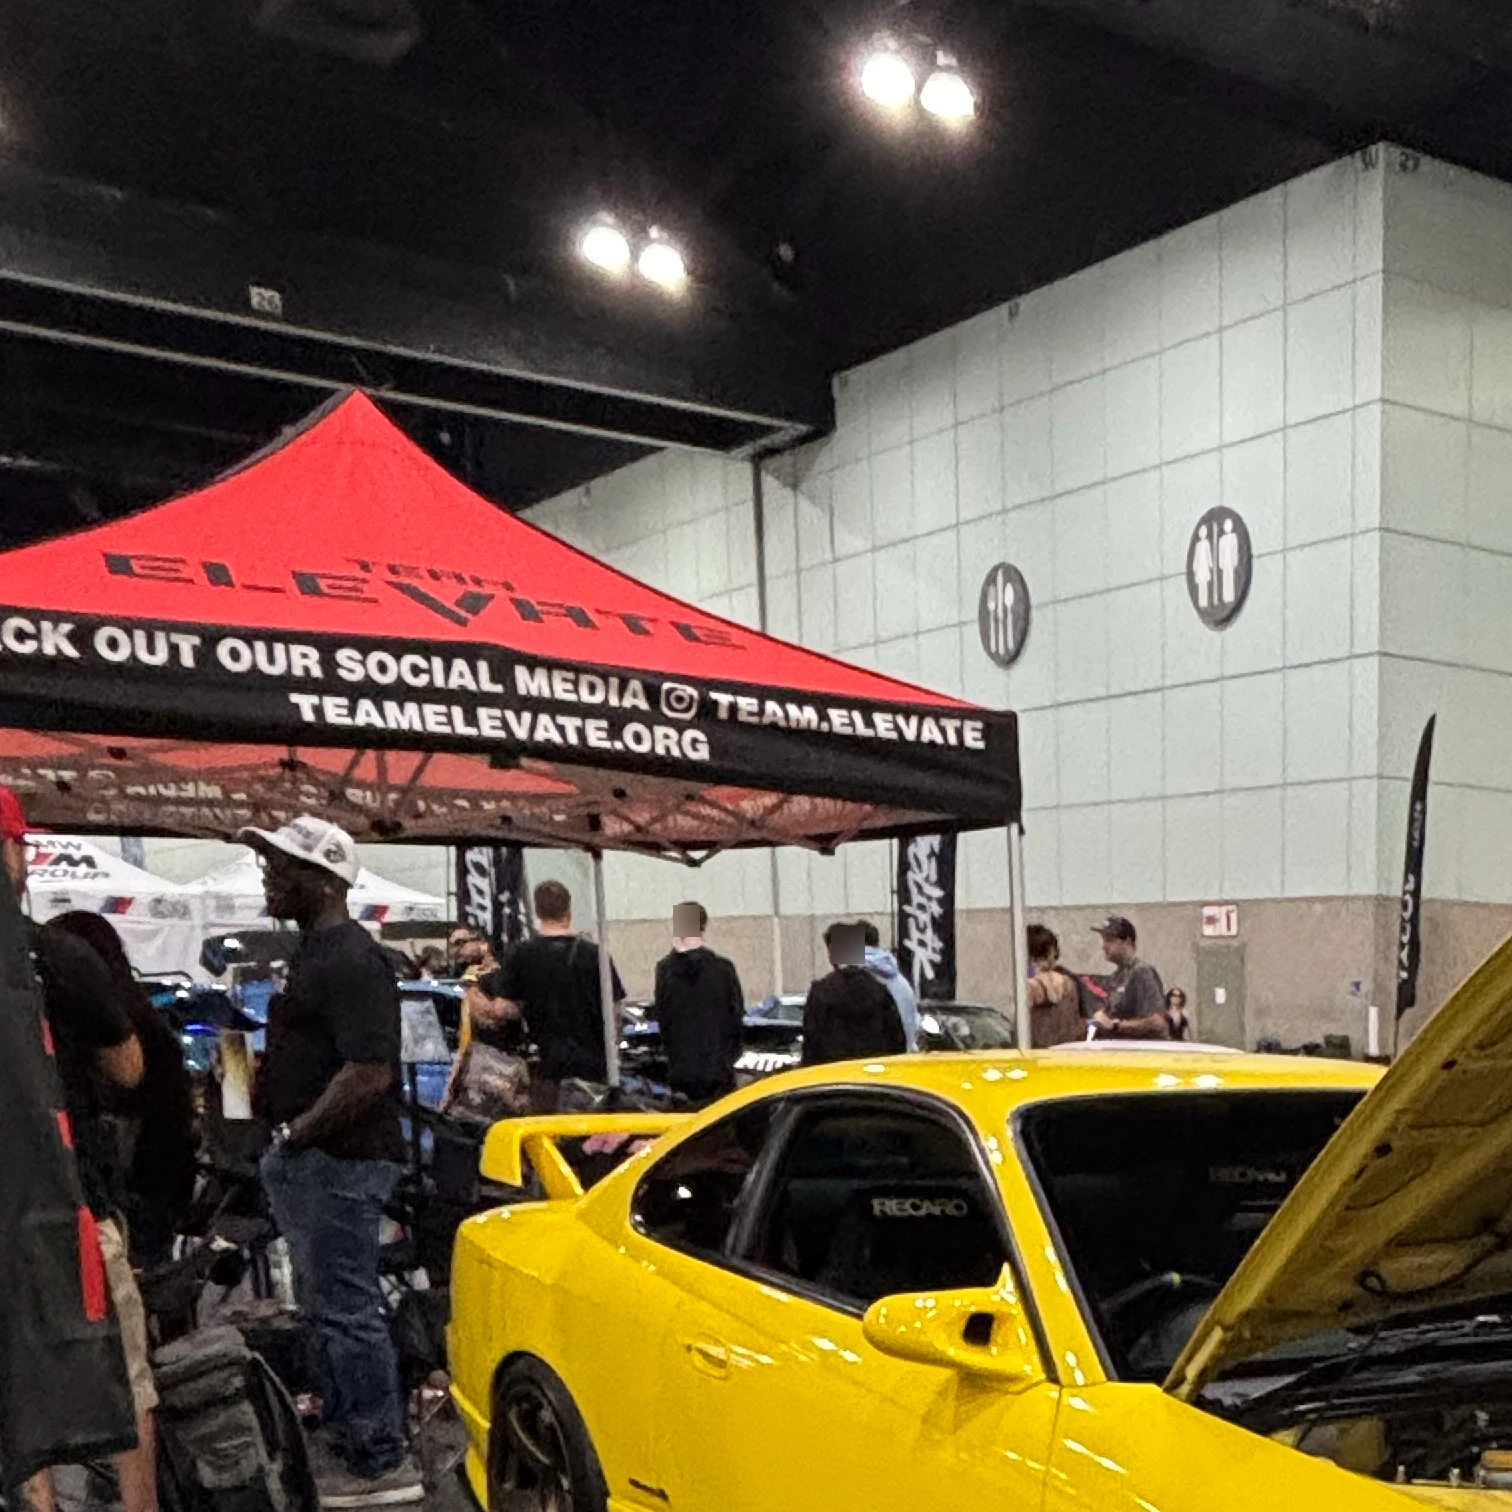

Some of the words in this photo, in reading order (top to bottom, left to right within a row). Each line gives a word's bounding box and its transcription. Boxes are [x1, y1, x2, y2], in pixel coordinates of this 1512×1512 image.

[102, 552, 747, 651] ELEVATE
[0, 616, 81, 658] CK
[94, 626, 200, 668] OUT
[217, 638, 322, 678] OUR
[336, 648, 503, 694] SOCIAL
[515, 664, 650, 711] MEDIA
[710, 691, 986, 750] TEAM.ELEVATE
[289, 691, 710, 761] TEAMELEVATE.ORG
[872, 1198, 968, 1217] RECARO
